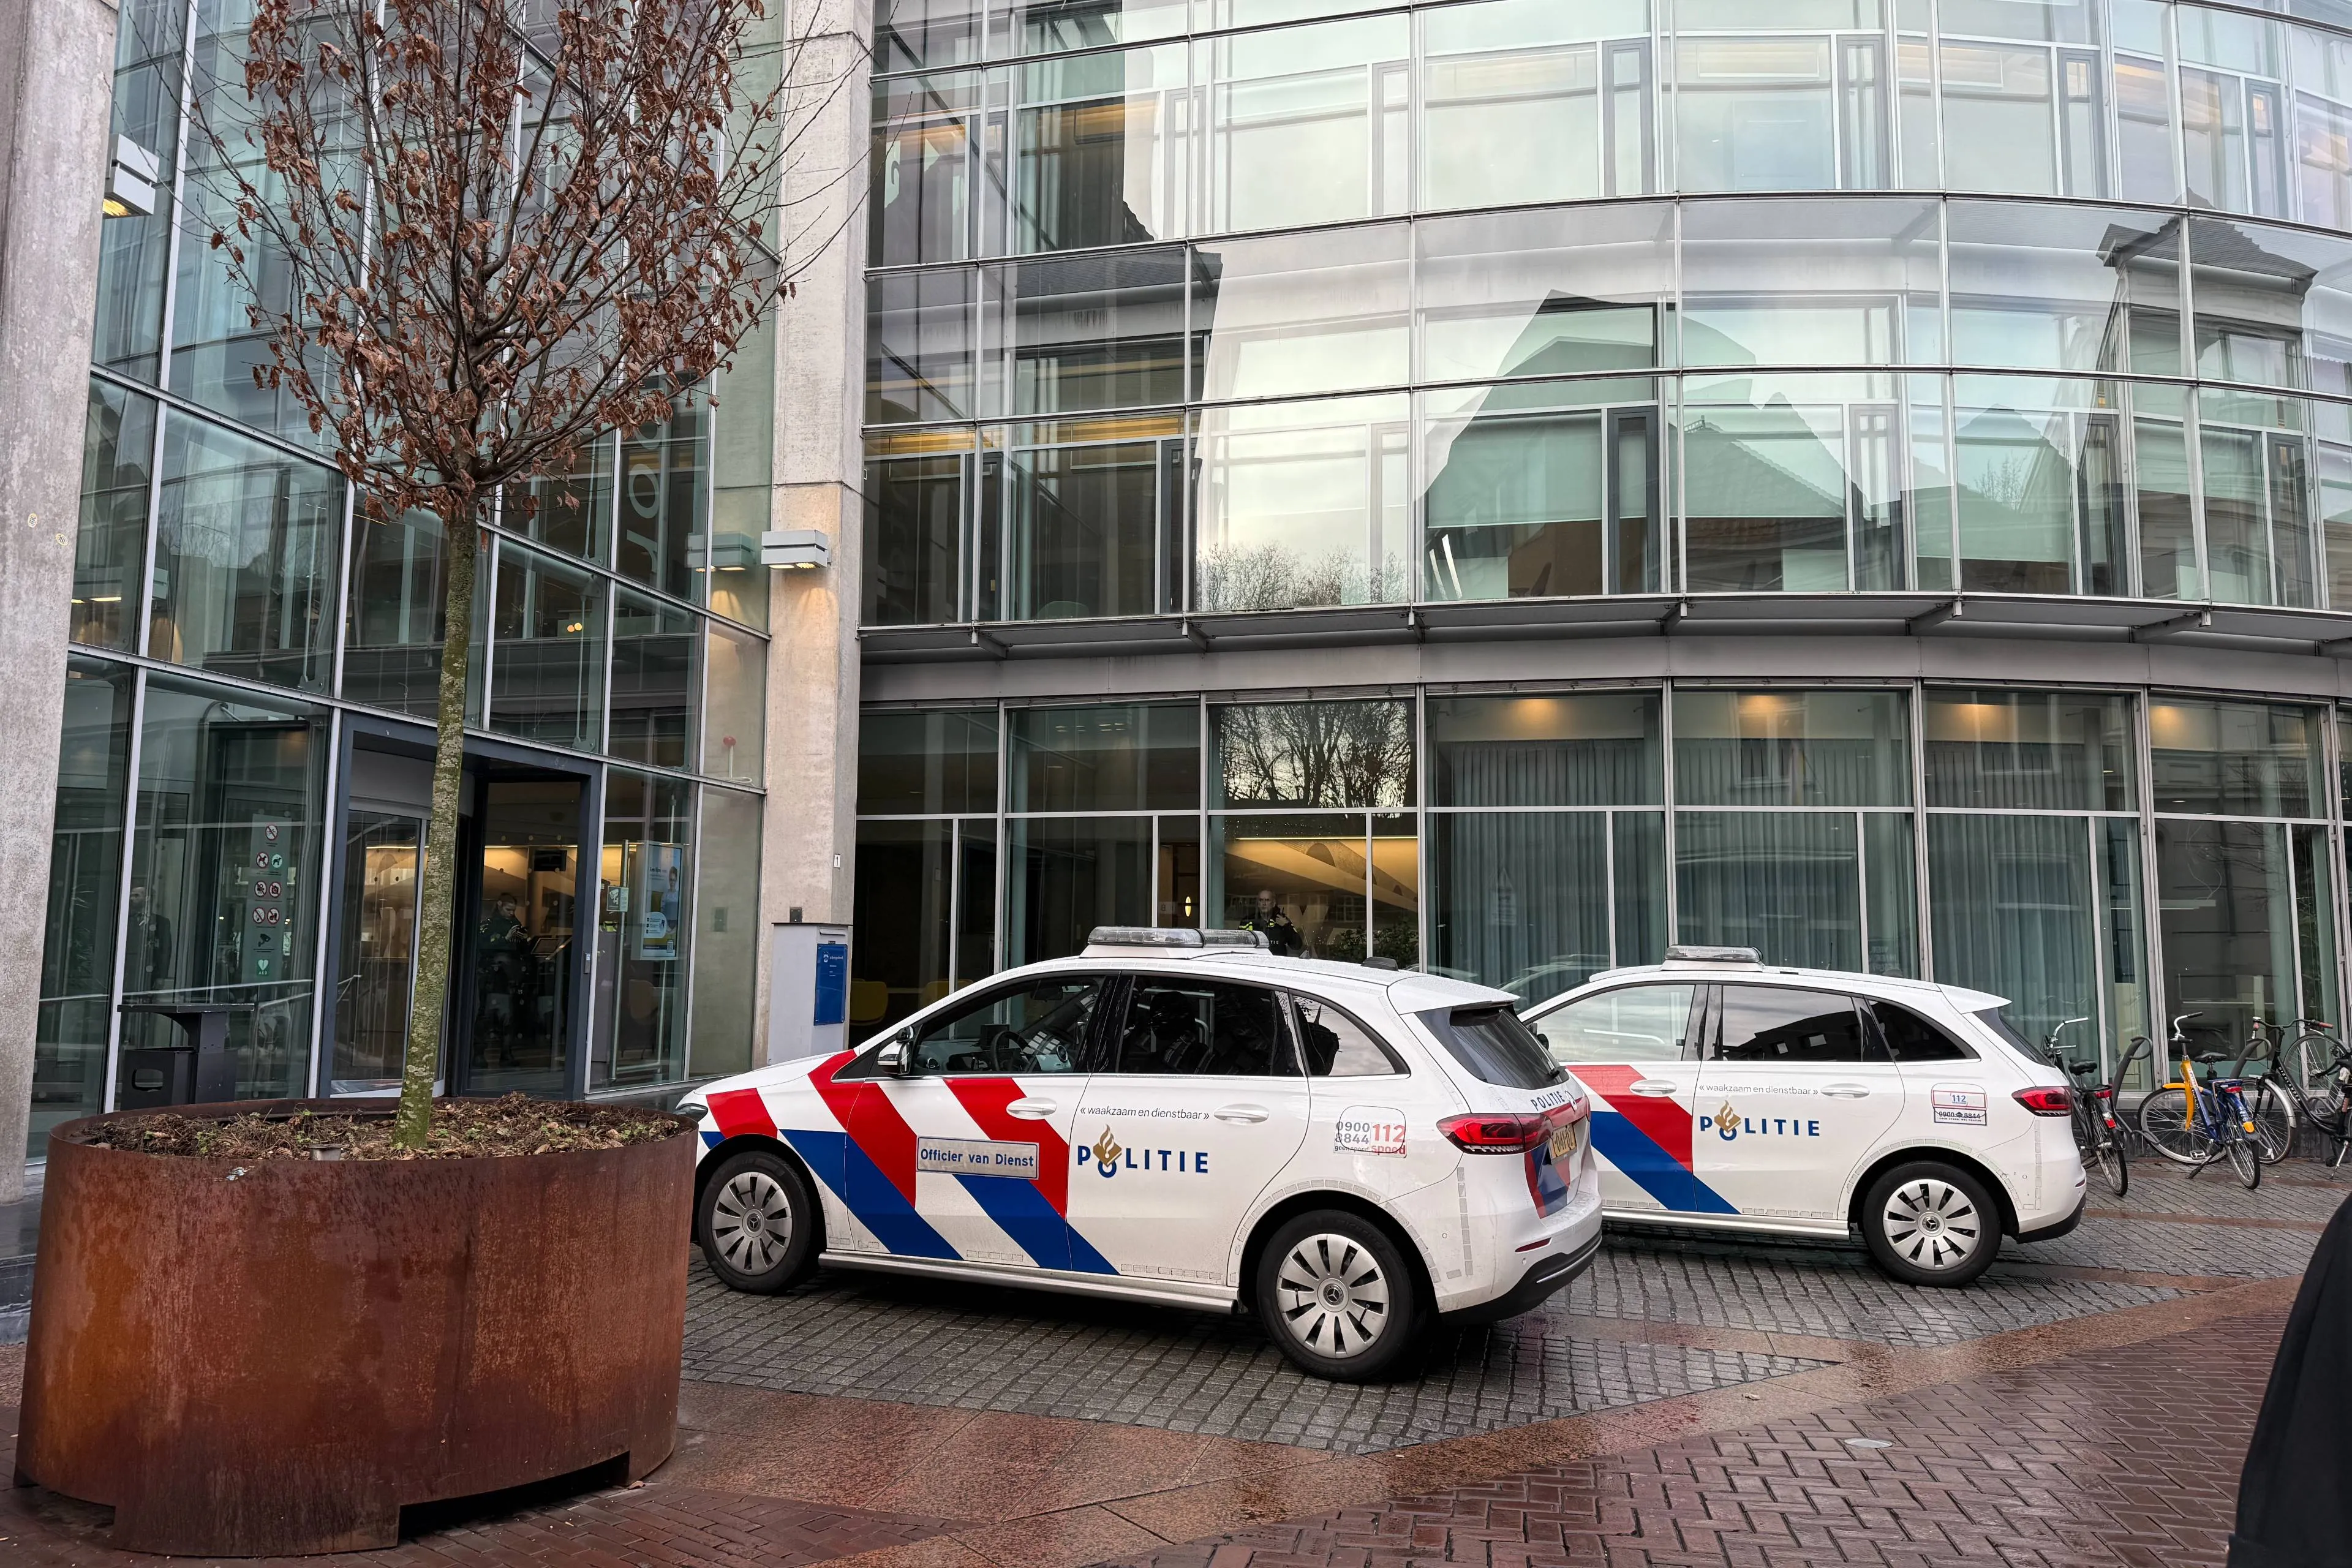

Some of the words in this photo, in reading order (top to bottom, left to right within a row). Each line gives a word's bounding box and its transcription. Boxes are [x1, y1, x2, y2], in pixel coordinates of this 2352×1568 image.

[1765, 1086, 1811, 1095] dienstbaar
[1531, 1091, 1566, 1111] POLITIE
[1088, 1106, 1136, 1117] waakzaam
[1138, 1109, 1150, 1117] en
[1152, 1107, 1202, 1120] dienstbaar
[1336, 1121, 1370, 1132] 0900
[1372, 1123, 1406, 1142] 112
[1700, 1115, 1820, 1141] POLITIE
[1335, 1133, 1370, 1144] 8844
[921, 1148, 963, 1162] Officier
[968, 1153, 989, 1164] van
[996, 1153, 1034, 1167] Dienst
[1077, 1145, 1208, 1178] POLITIE
